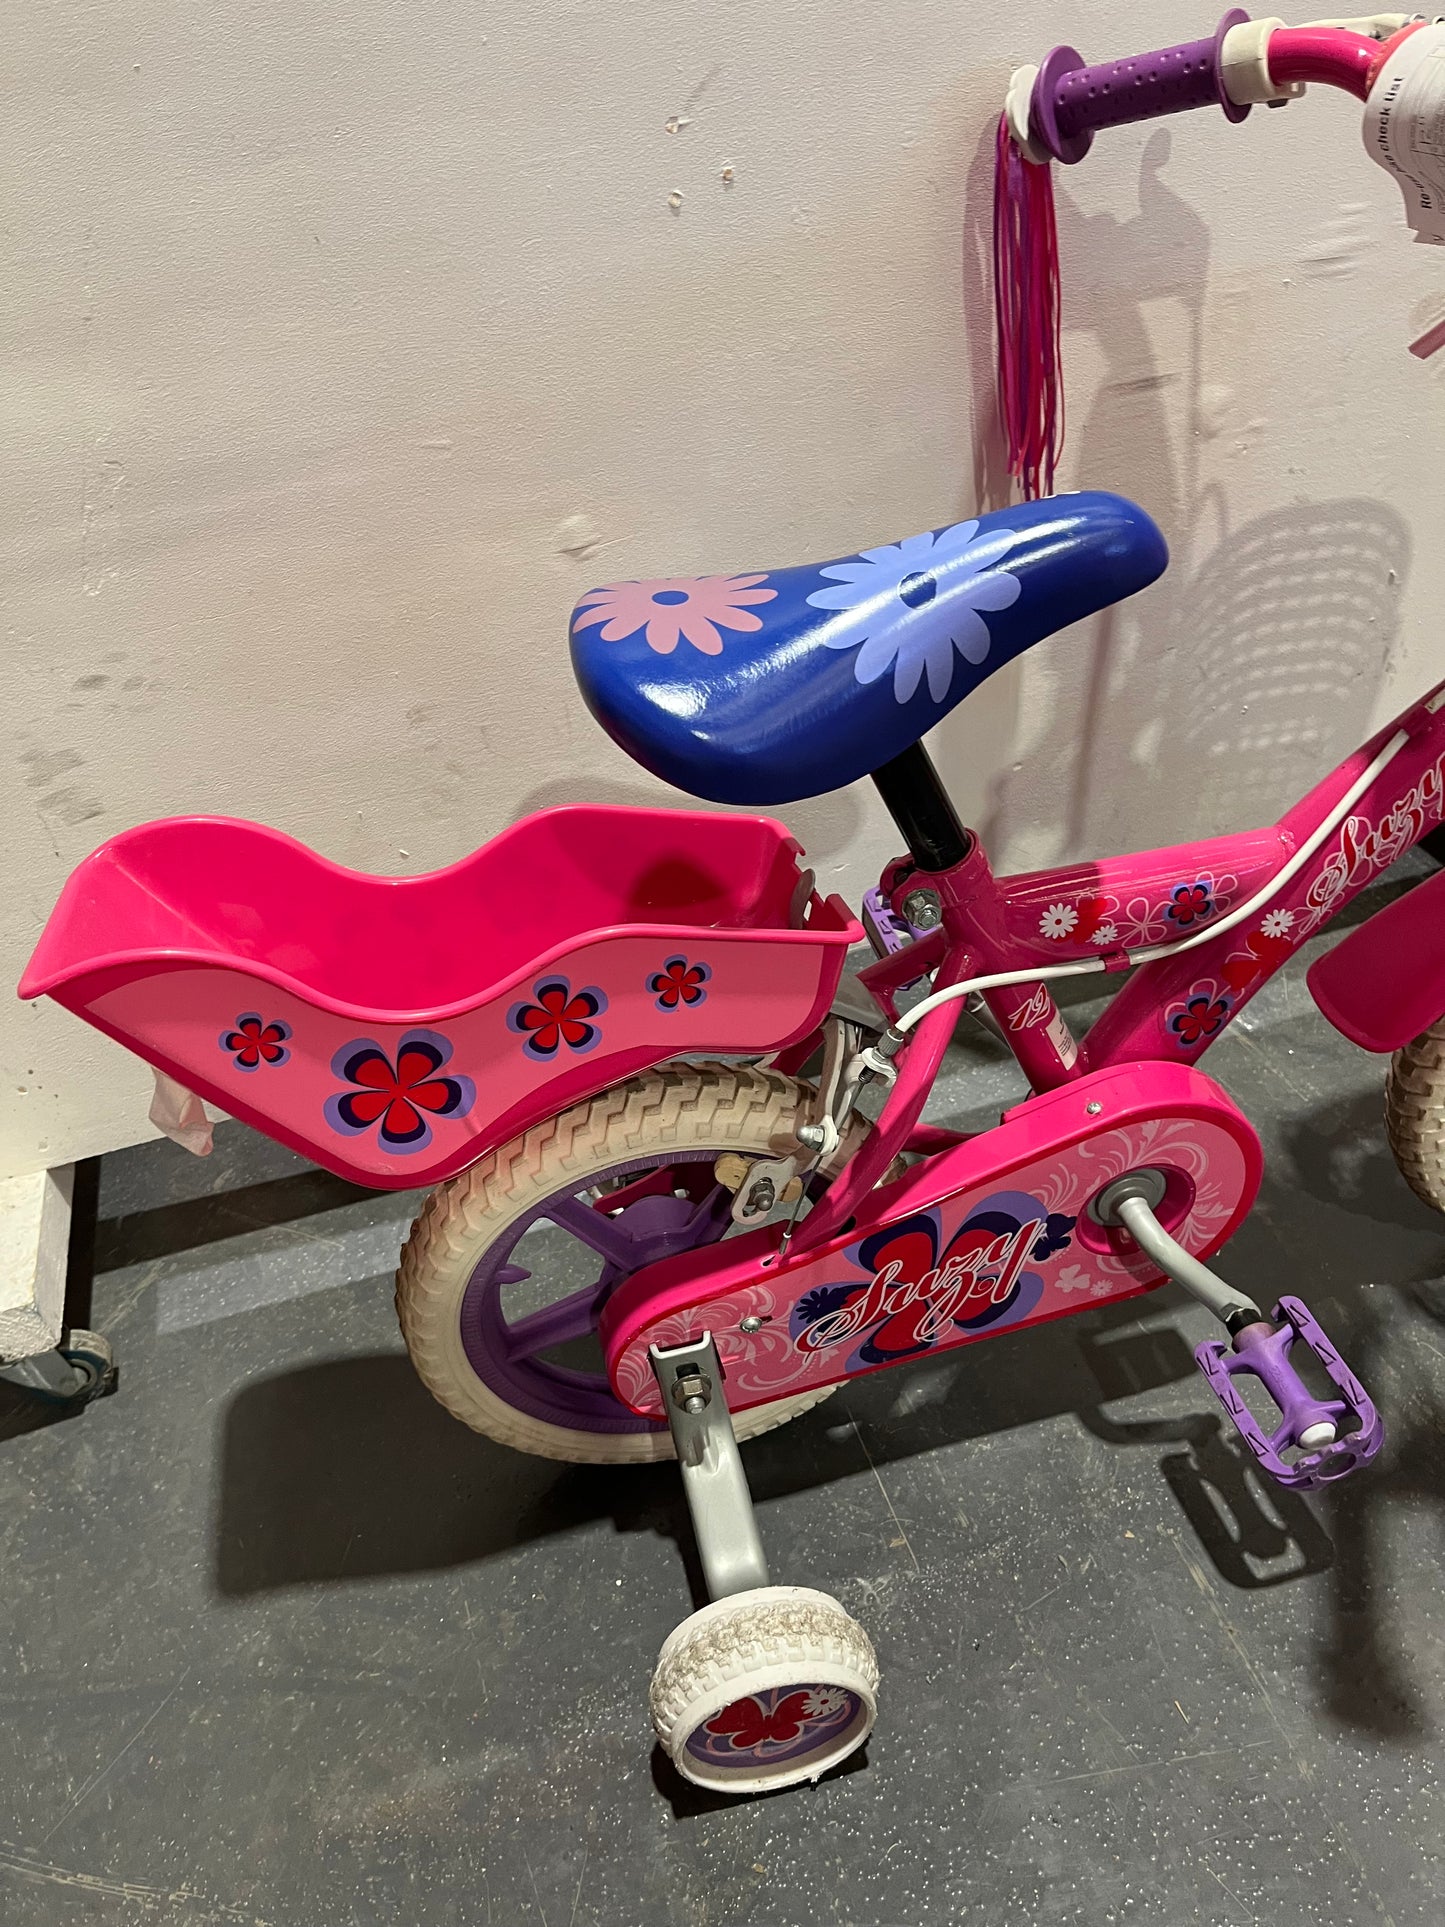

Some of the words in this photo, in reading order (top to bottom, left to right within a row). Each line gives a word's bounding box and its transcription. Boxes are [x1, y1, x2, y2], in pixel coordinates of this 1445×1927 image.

[1383, 77, 1404, 102] list
[1377, 107, 1392, 151] check
[1007, 983, 1051, 1032] 12
[794, 1217, 1048, 1364] Suzy
